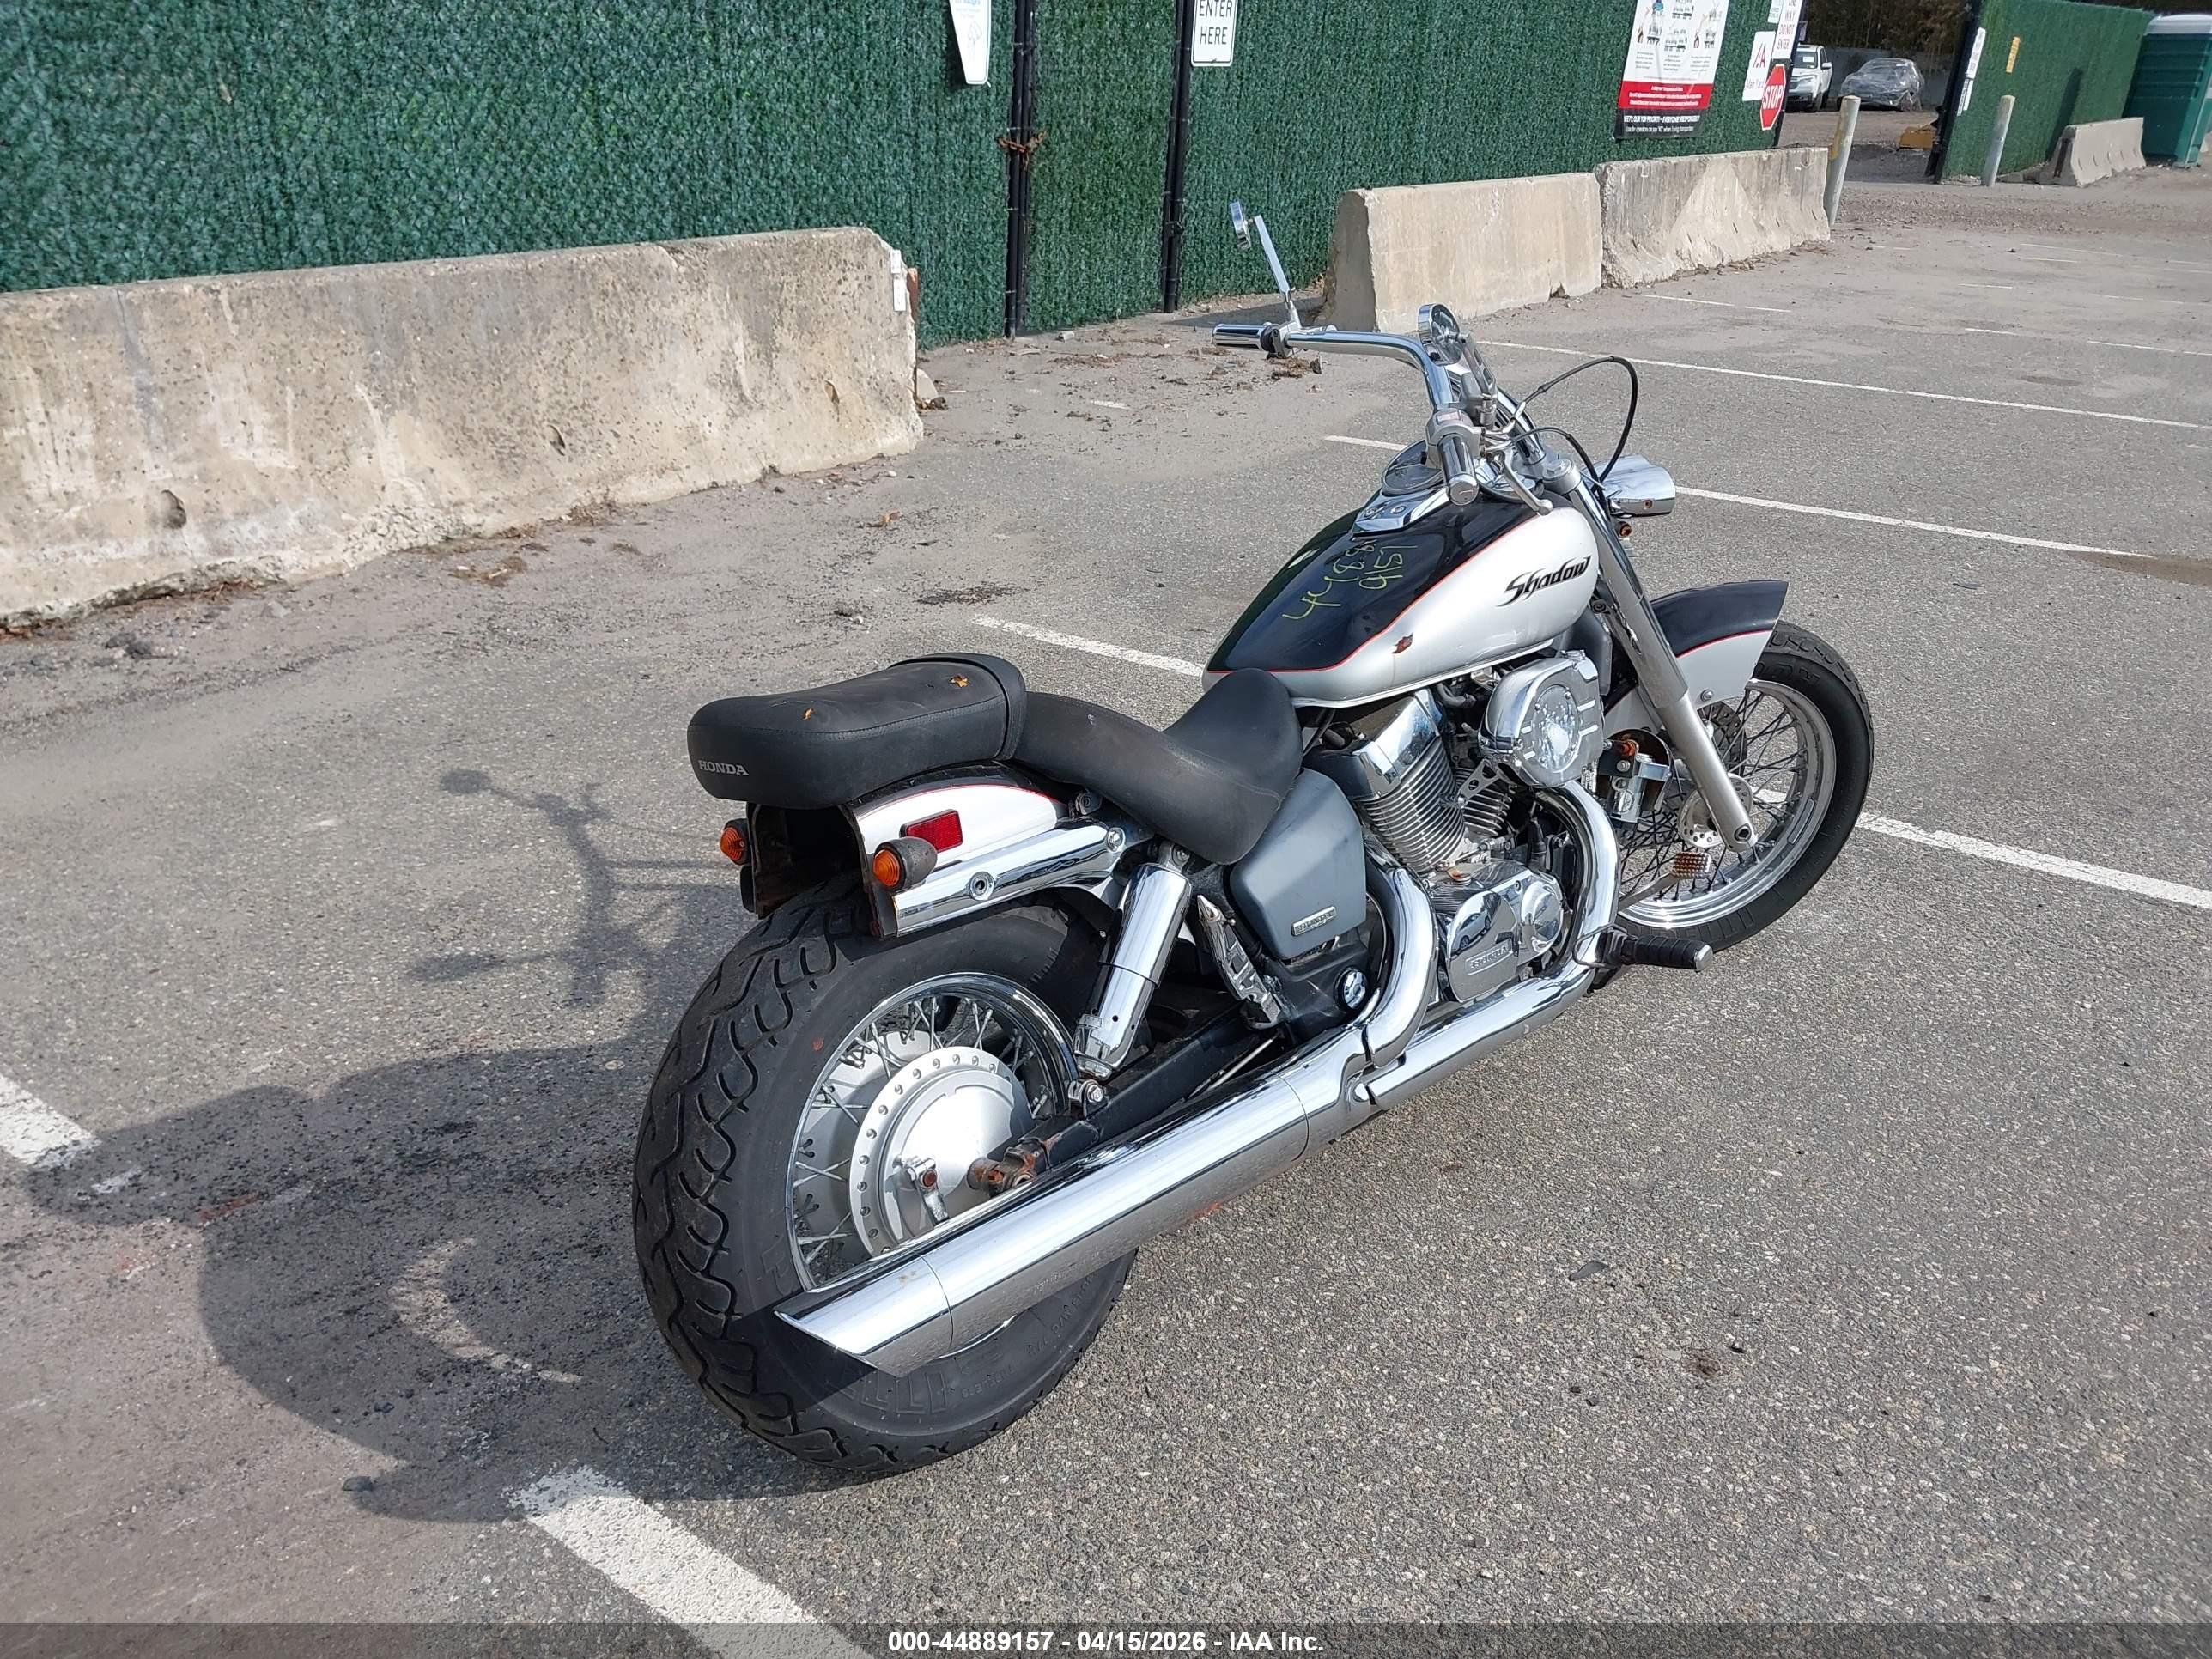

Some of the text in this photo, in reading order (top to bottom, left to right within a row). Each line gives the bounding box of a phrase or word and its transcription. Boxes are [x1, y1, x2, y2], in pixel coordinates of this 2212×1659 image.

[1199, 0, 1233, 17] ENTER
[1200, 26, 1228, 45] HERE
[1763, 84, 1784, 110] STOP
[1495, 556, 1592, 608] Shadow
[697, 759, 750, 776] HONDA
